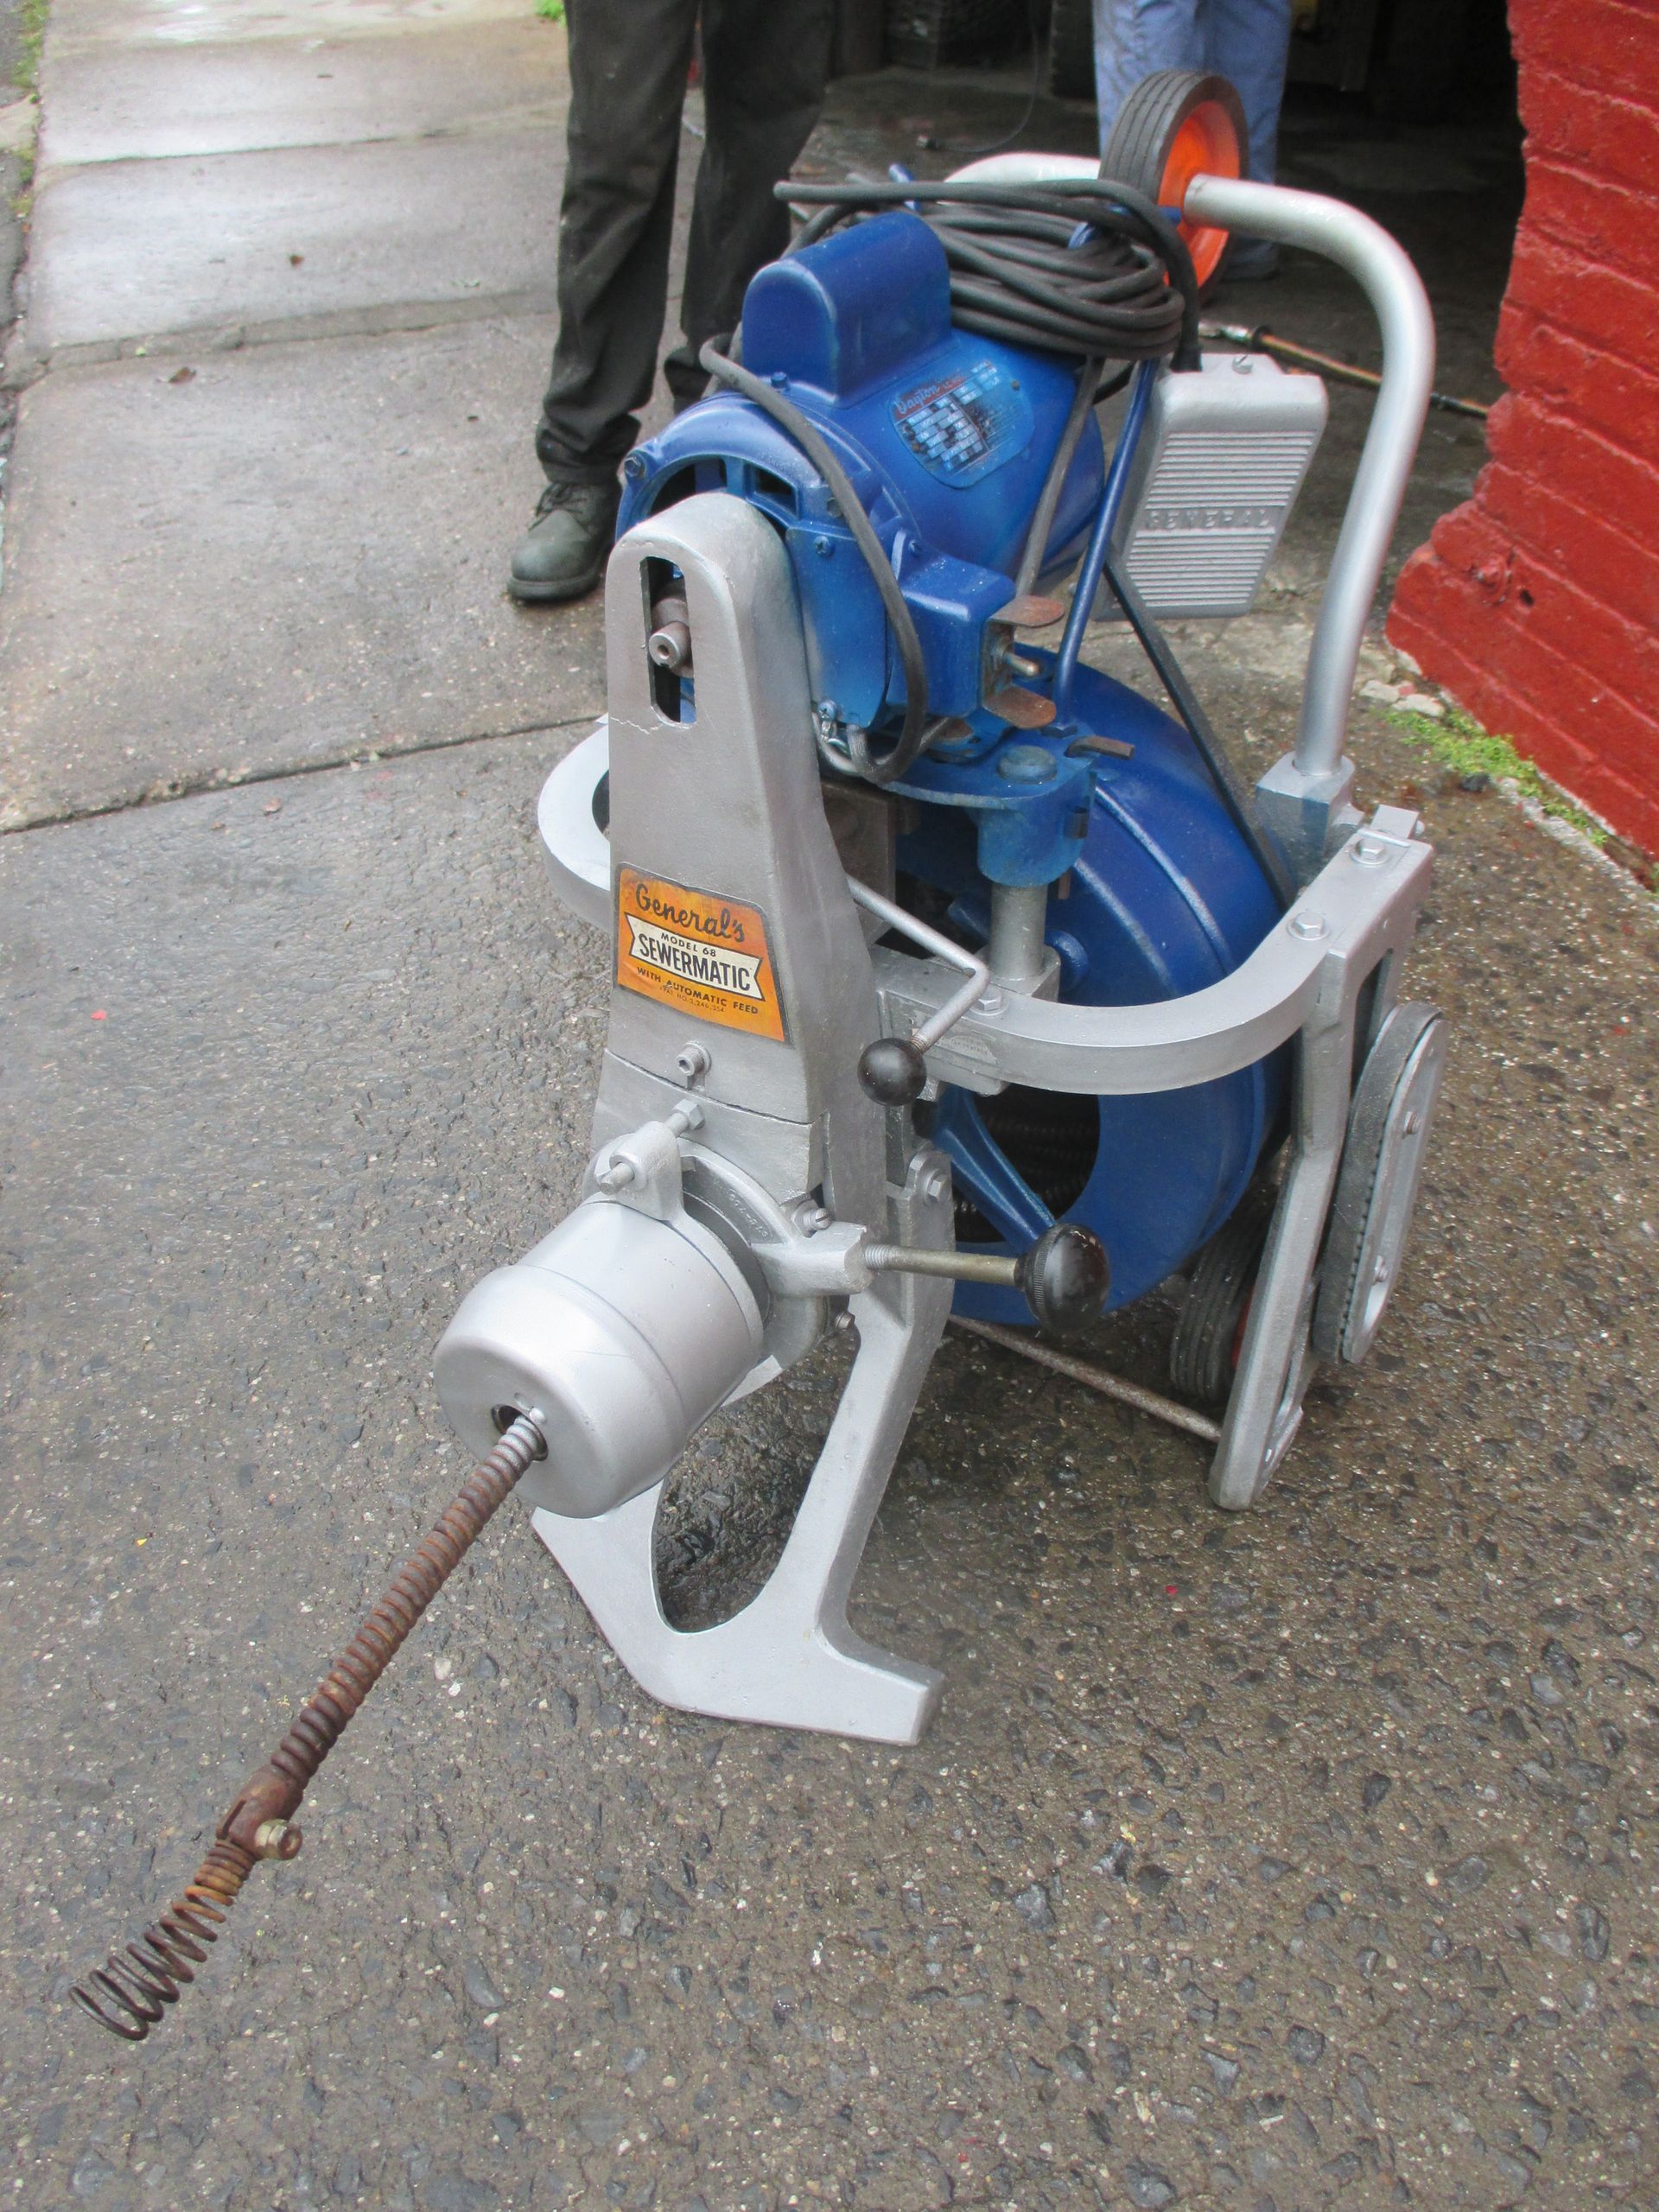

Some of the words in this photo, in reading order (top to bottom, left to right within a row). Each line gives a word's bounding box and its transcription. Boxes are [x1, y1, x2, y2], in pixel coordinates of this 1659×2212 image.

[636, 884, 745, 942] General's
[639, 934, 750, 991] SEWERMATIC
[661, 932, 697, 951] MODEL
[702, 944, 716, 957] 68
[638, 966, 662, 983] WITH
[666, 979, 728, 1007] AUTOMATIC
[733, 1001, 758, 1014] FEED
